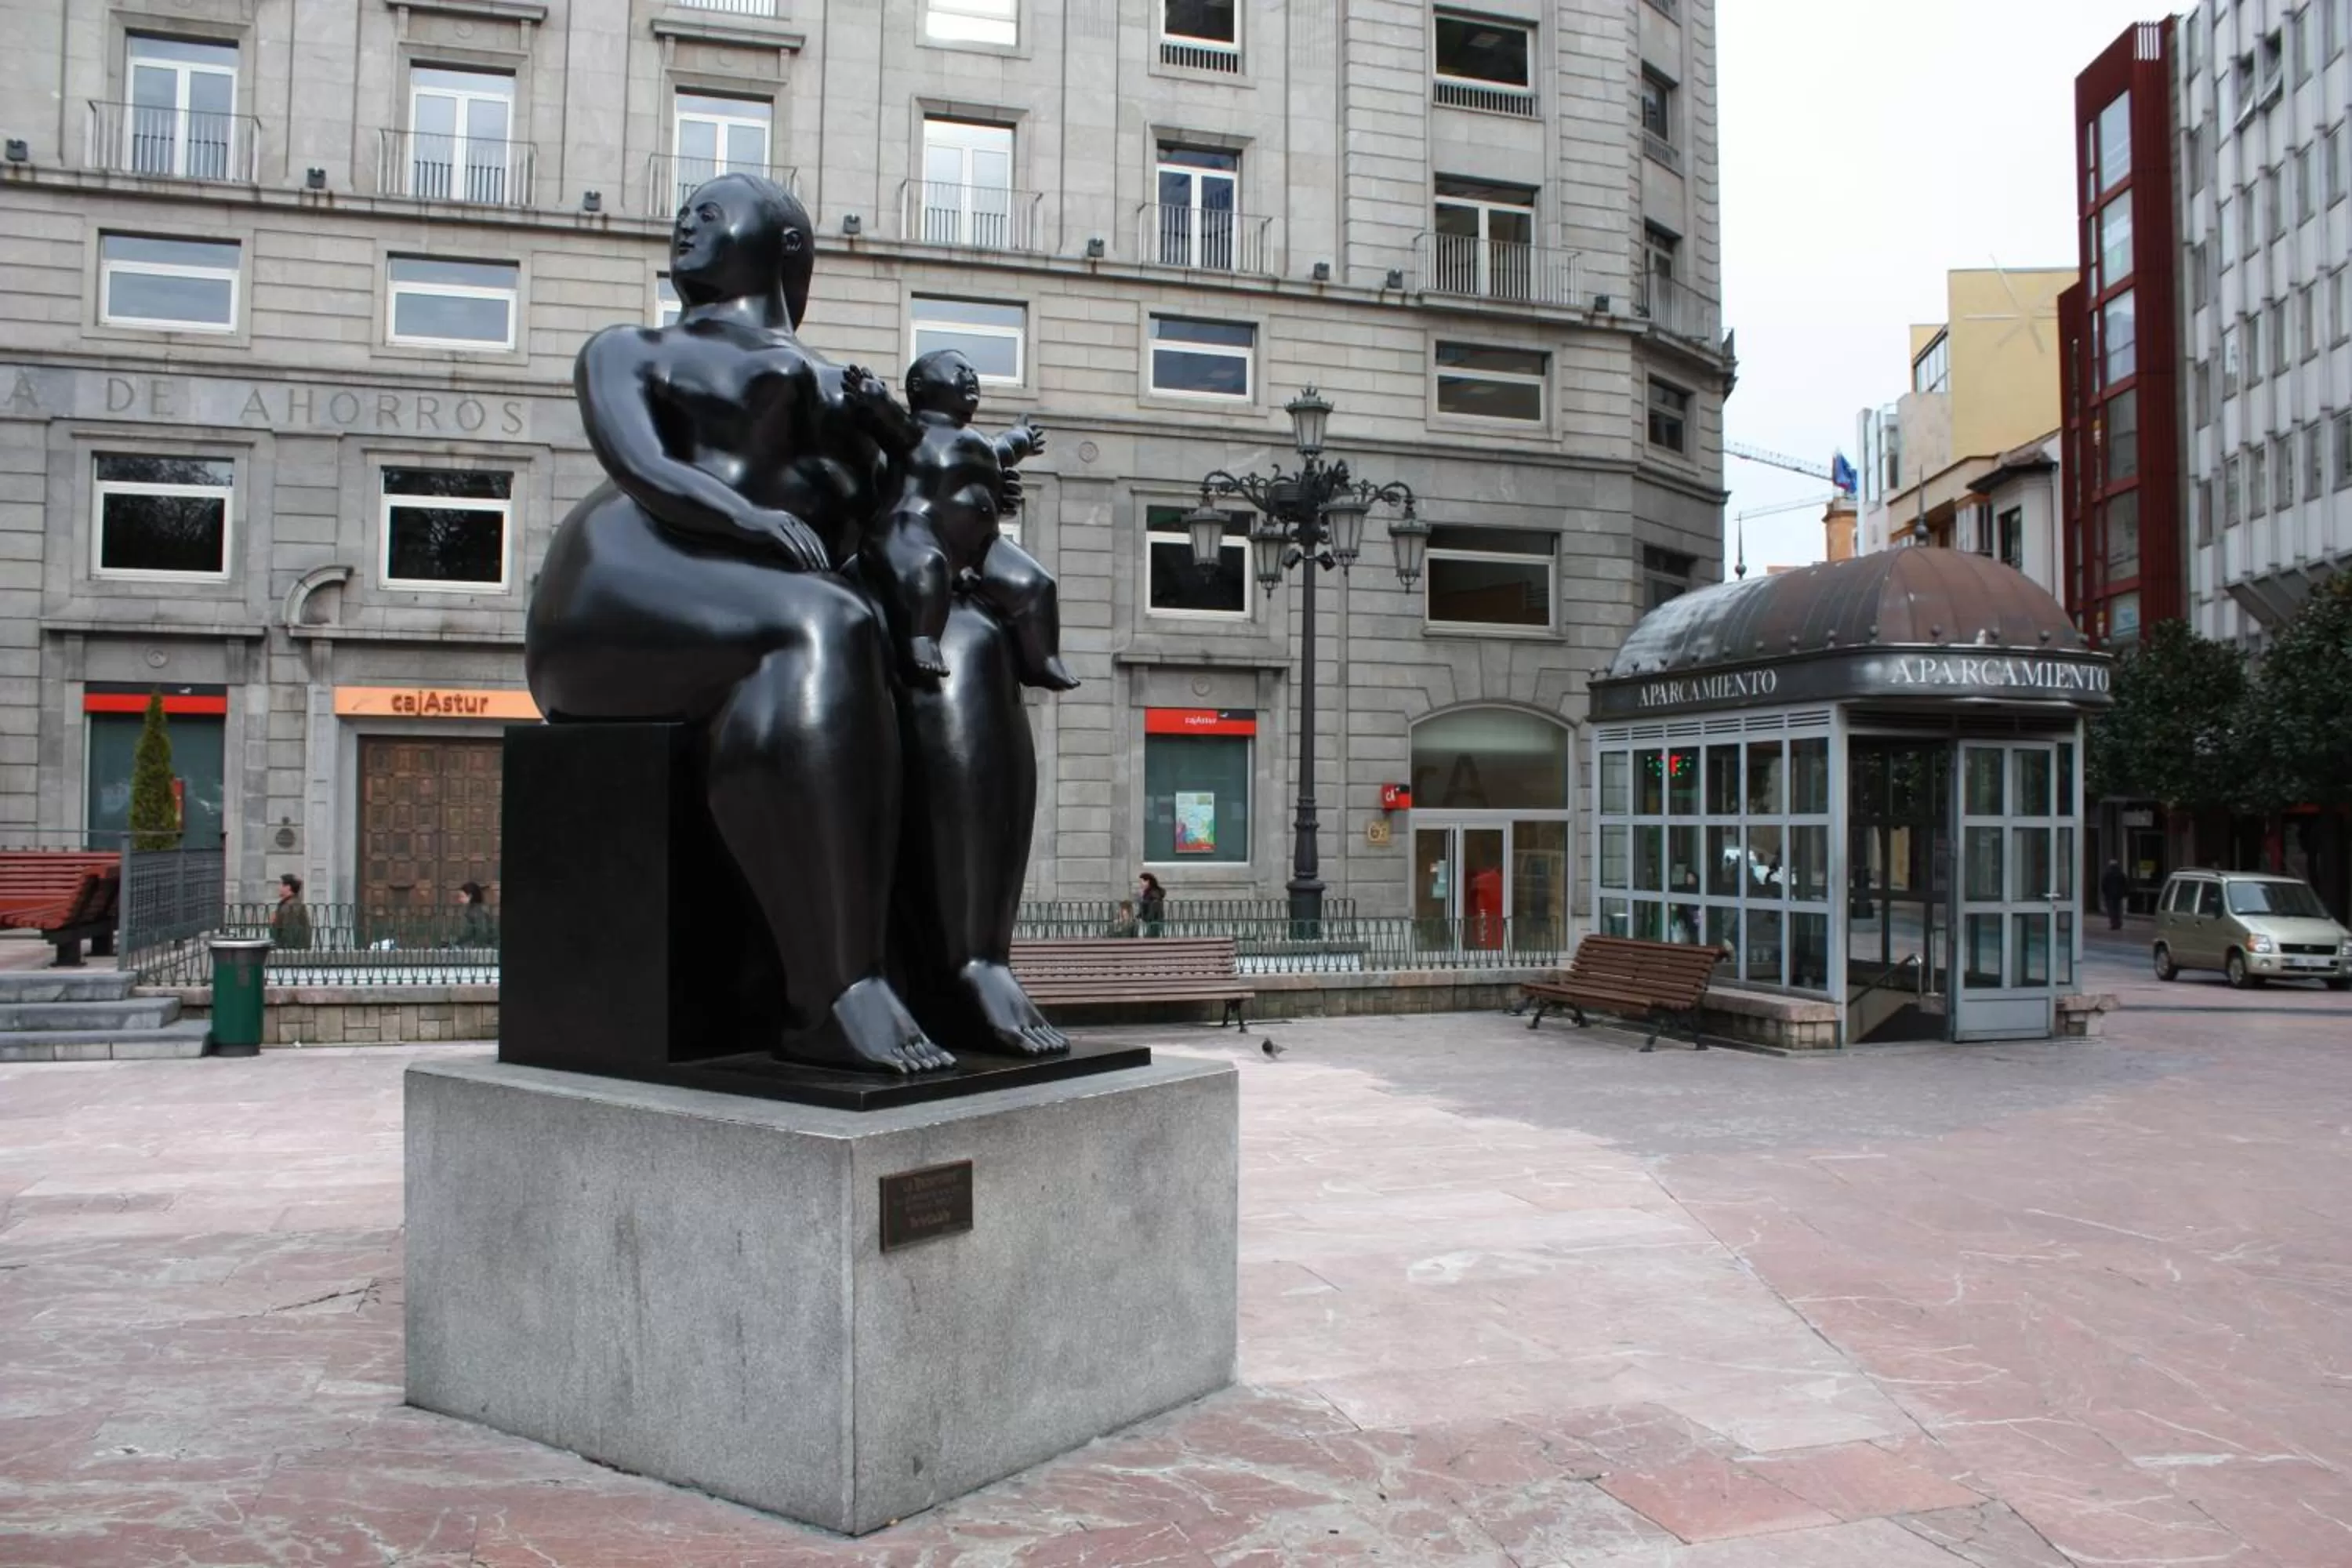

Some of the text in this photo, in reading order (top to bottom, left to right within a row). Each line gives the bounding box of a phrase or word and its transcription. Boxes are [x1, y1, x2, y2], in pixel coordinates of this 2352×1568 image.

[107, 377, 175, 415] DE
[238, 388, 523, 434] AHORROS
[1639, 669, 1777, 707] APARCAMIENTO
[1890, 658, 2111, 691] APARCAMIENTO
[390, 690, 489, 717] cajAstur
